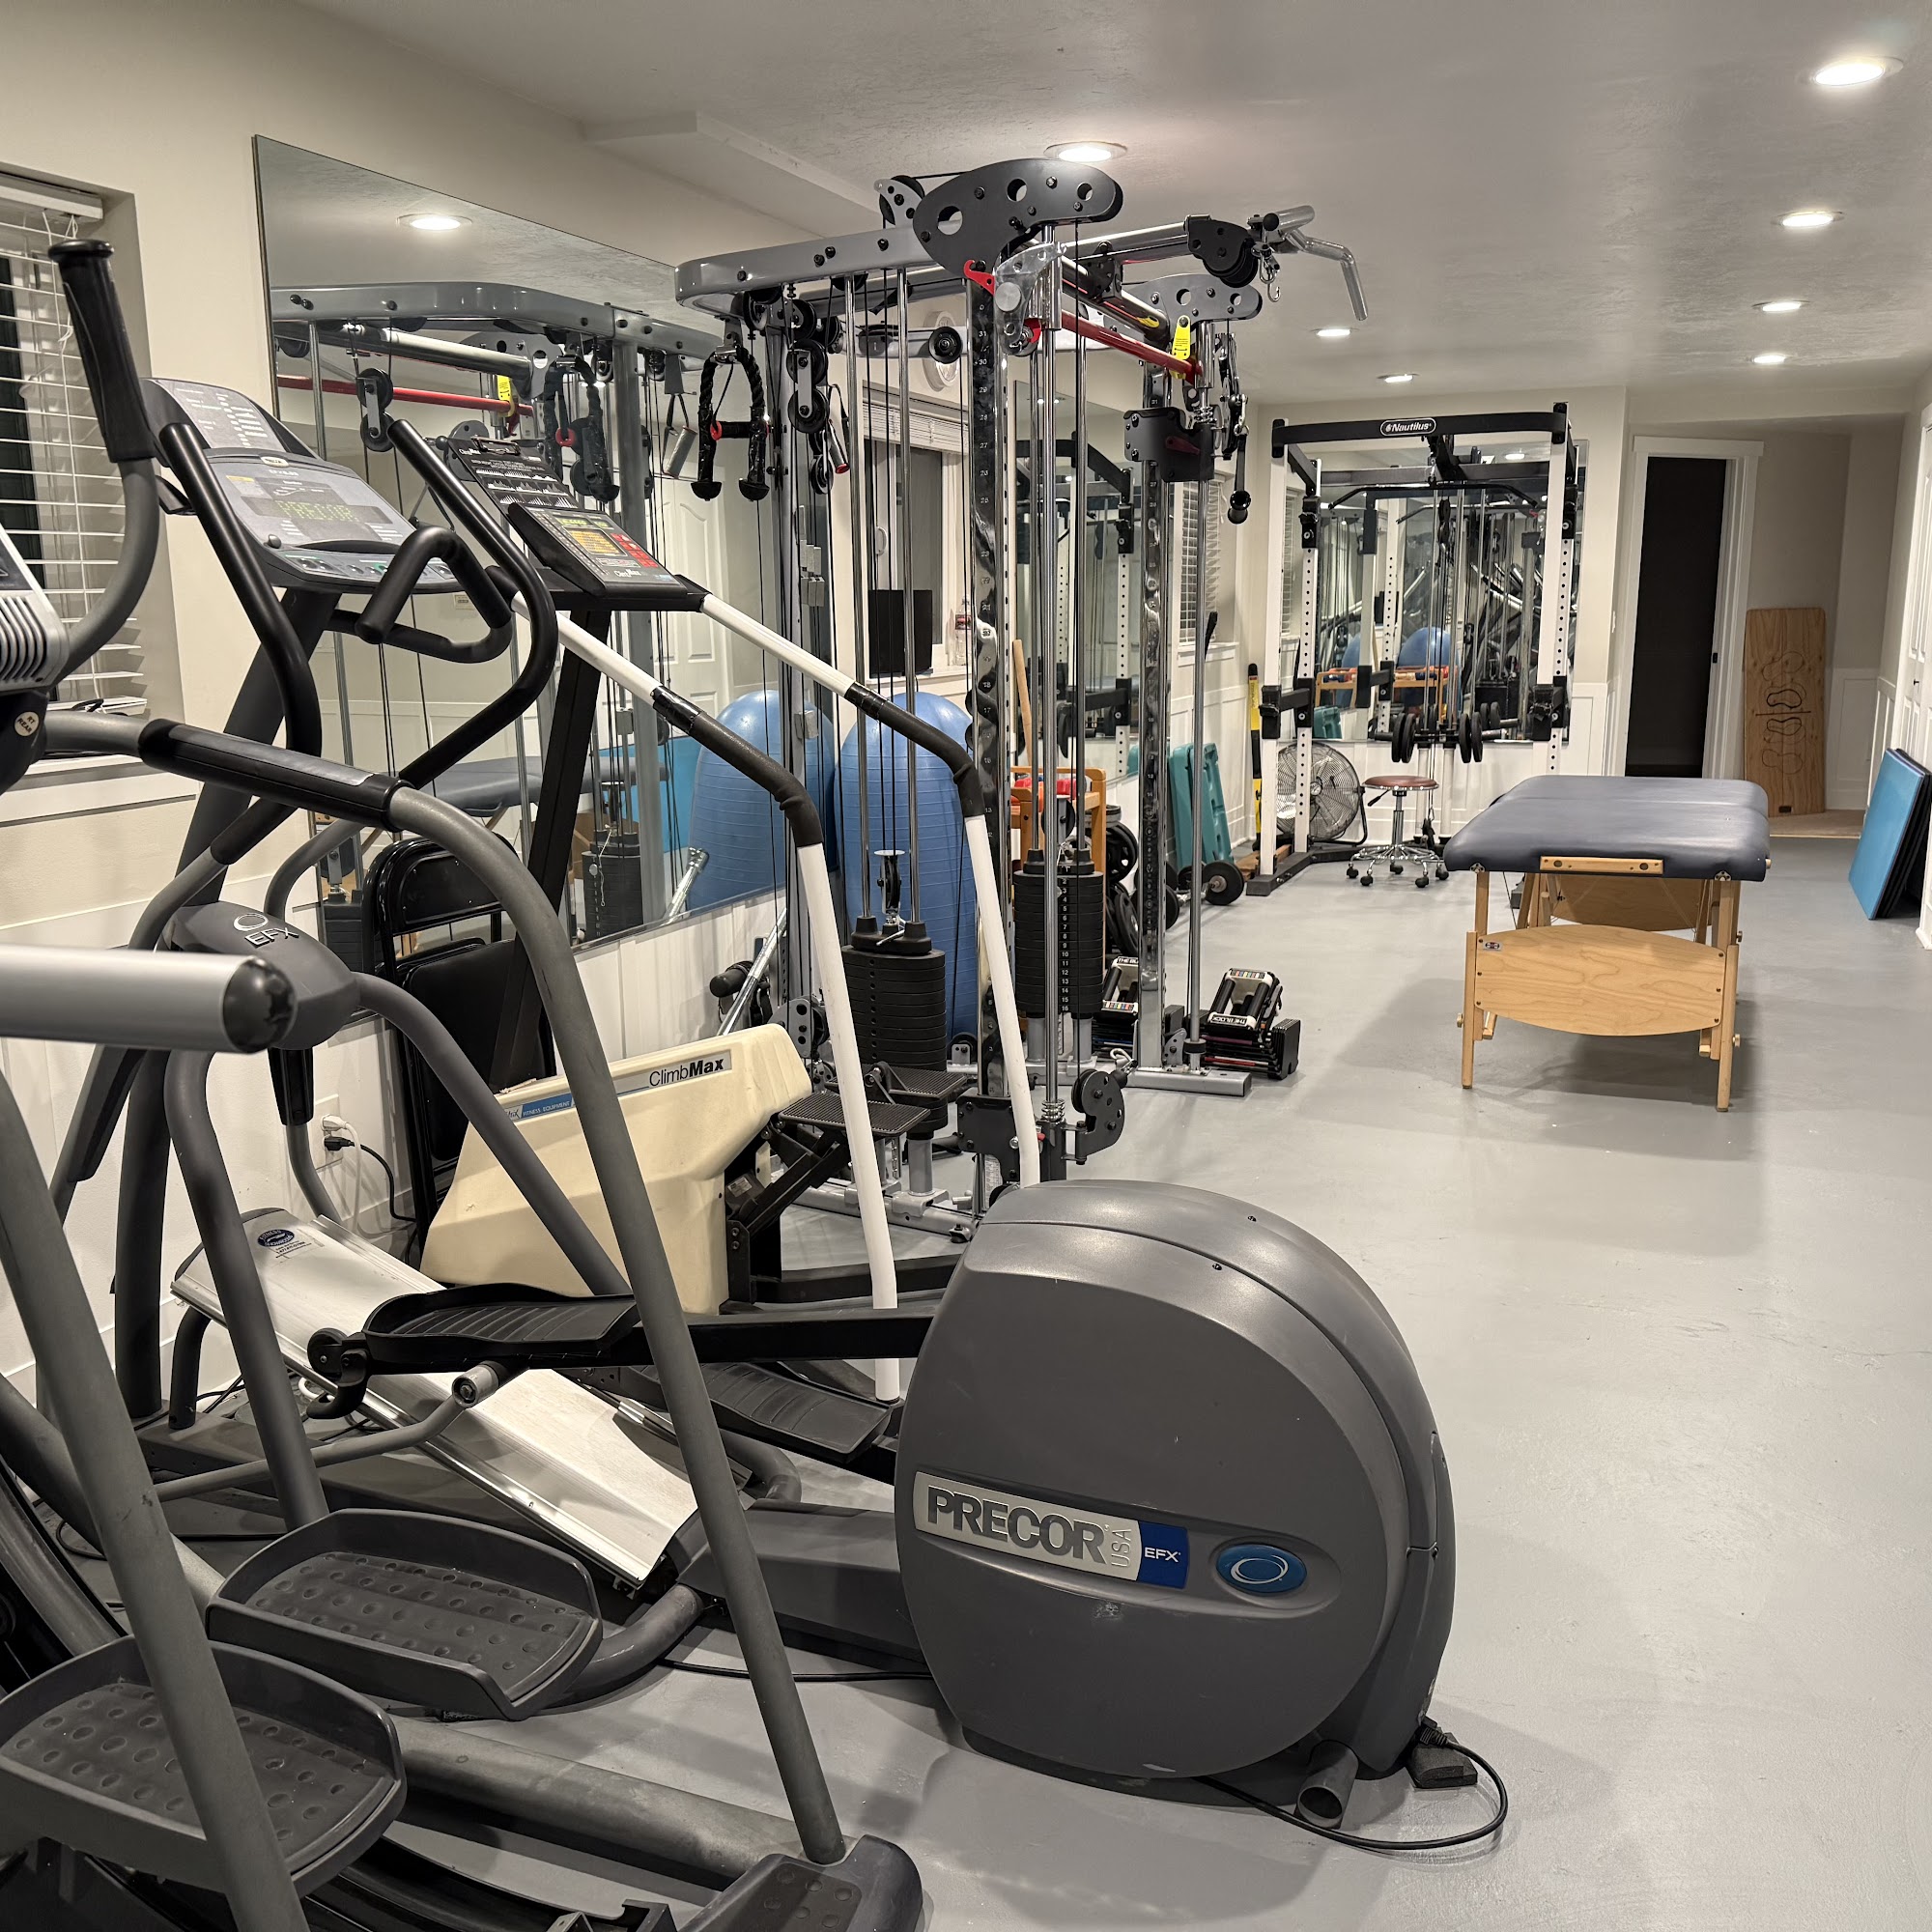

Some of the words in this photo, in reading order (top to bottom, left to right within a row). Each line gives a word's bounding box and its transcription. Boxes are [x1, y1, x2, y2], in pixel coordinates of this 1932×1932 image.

[1392, 422, 1429, 432] Nautilus
[275, 499, 360, 523] PRECOR
[17, 718, 32, 732] REAR
[27, 716, 36, 724] RT
[244, 927, 299, 948] EFX
[649, 1058, 724, 1087] ClimbMax
[523, 1108, 541, 1117] FITNESS
[543, 1101, 570, 1112] EQUIPMENT
[927, 1485, 1108, 1565] PRECOR
[1111, 1527, 1132, 1568] USA
[1145, 1548, 1179, 1563] EFX
